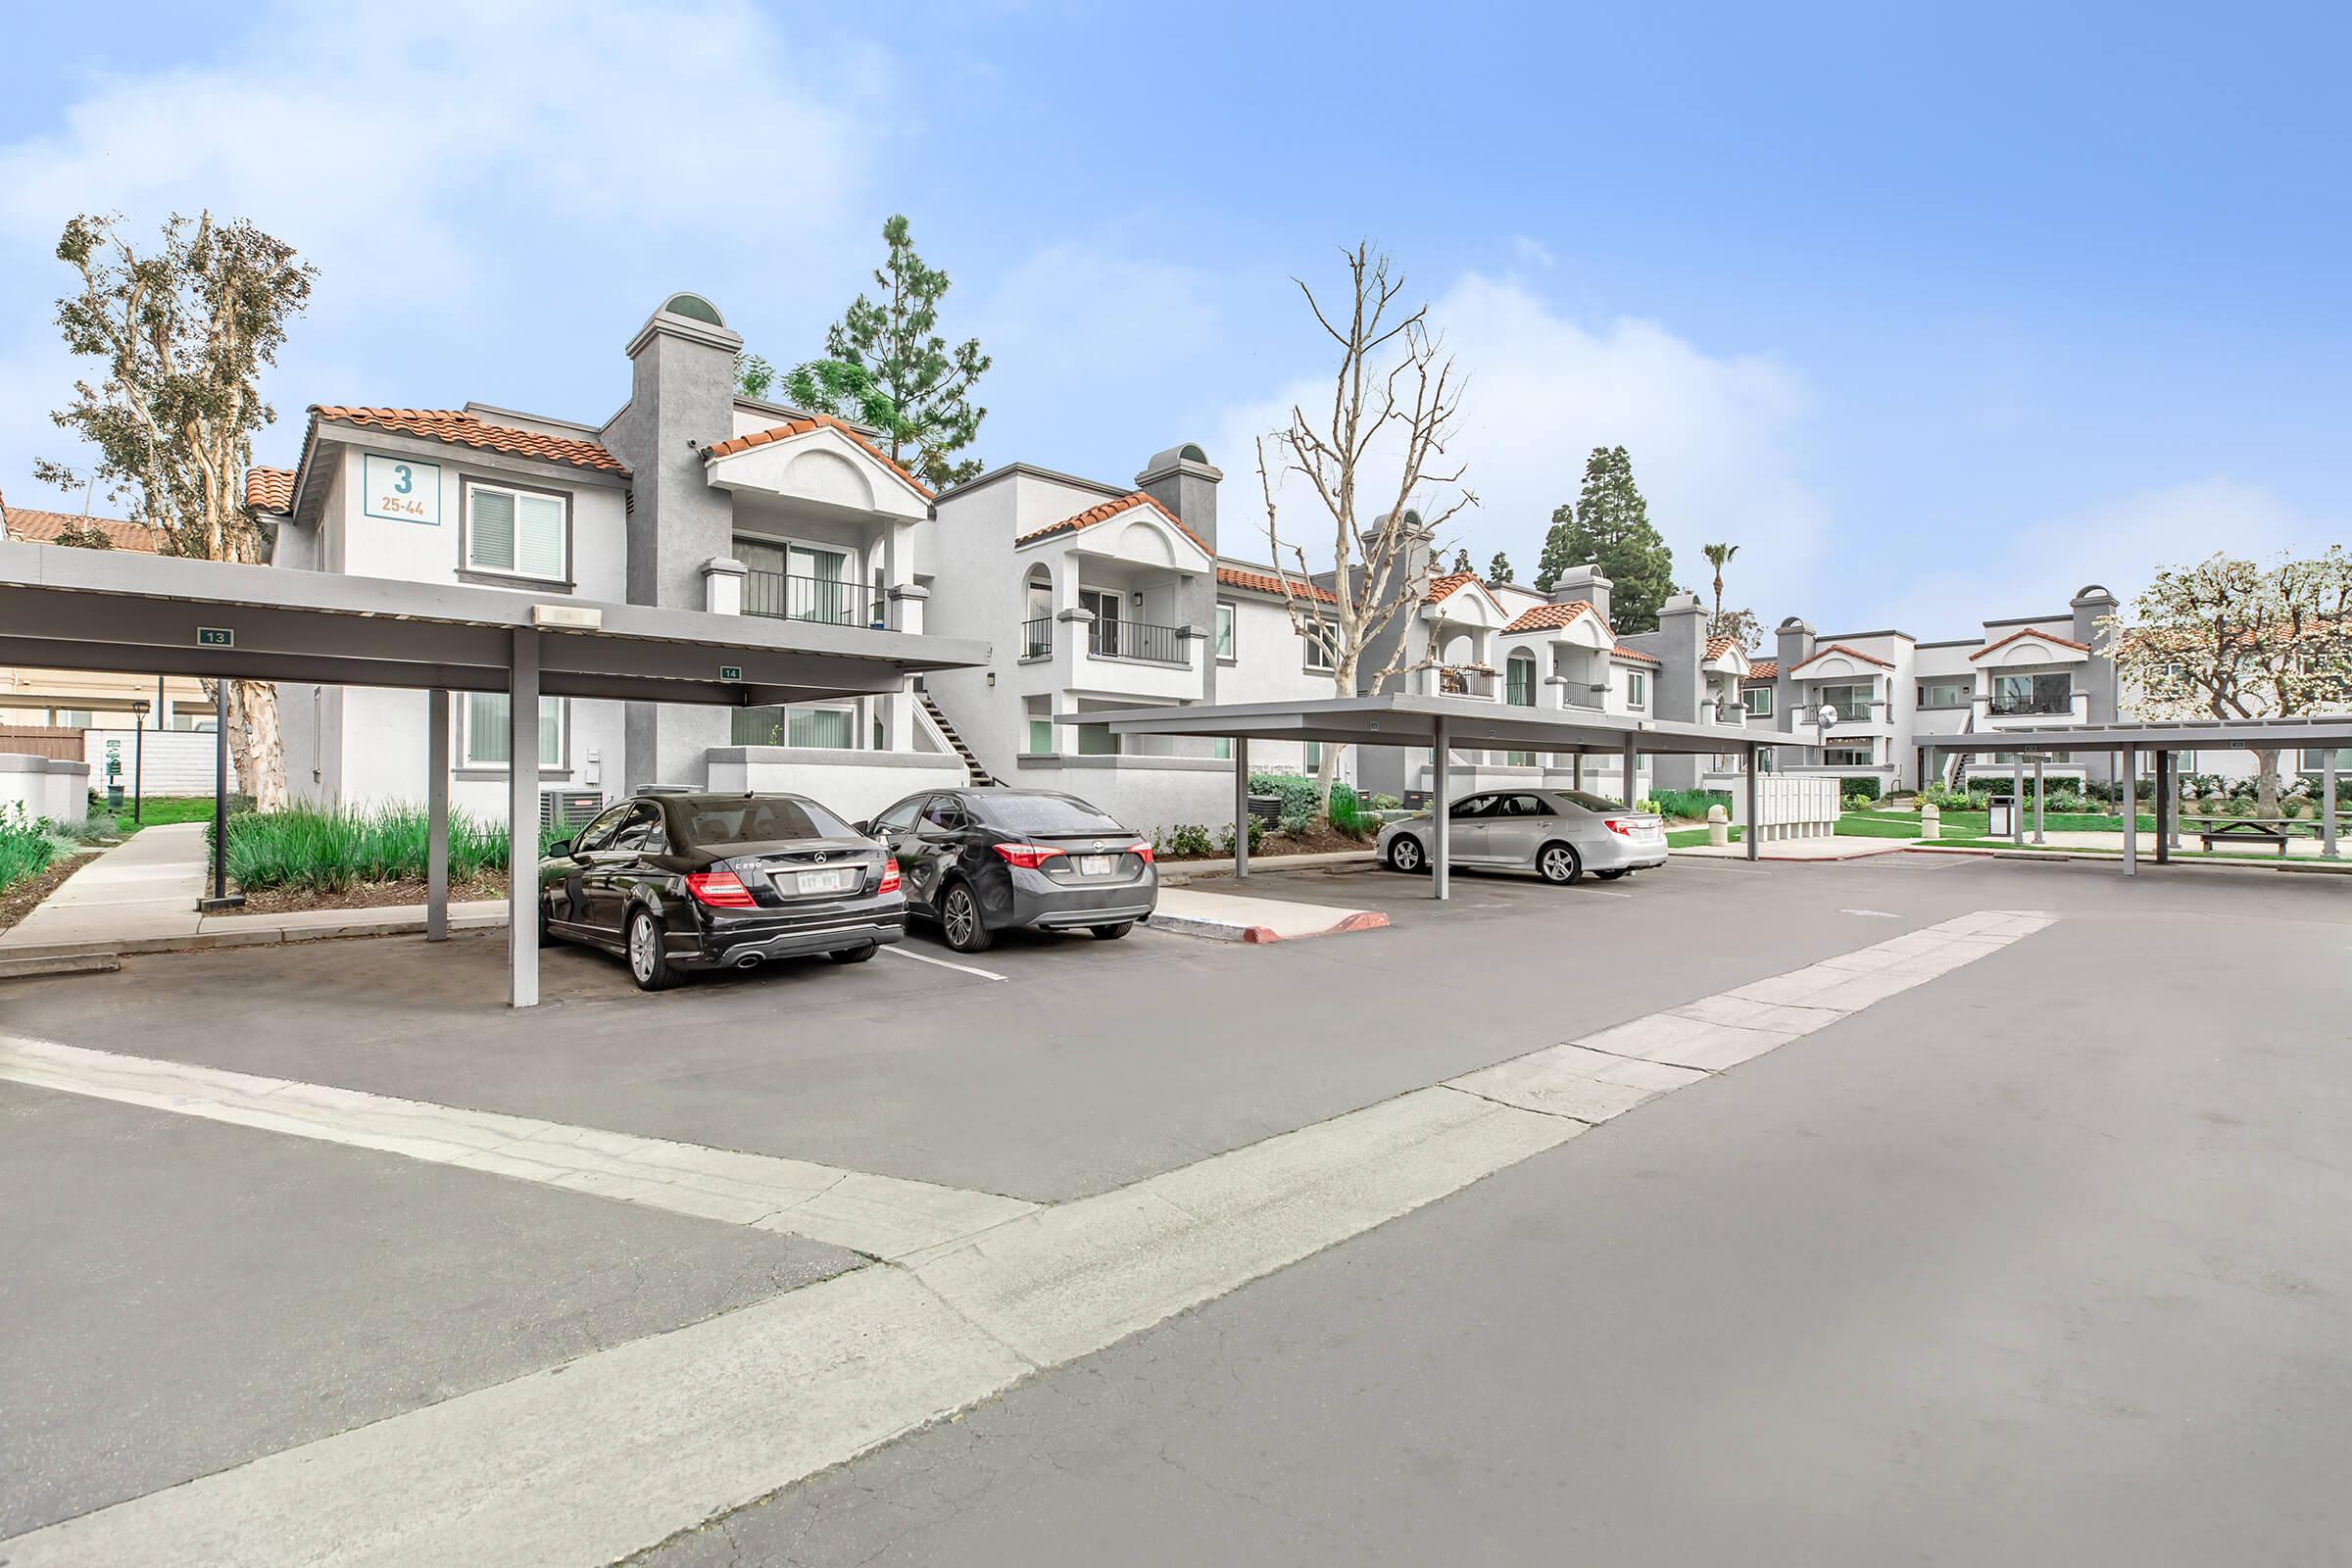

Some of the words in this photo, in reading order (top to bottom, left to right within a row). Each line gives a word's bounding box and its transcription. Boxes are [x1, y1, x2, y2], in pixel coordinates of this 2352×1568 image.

[394, 465, 412, 494] 3
[382, 496, 423, 515] 25-44
[206, 632, 224, 643] 13
[725, 669, 737, 678] 14
